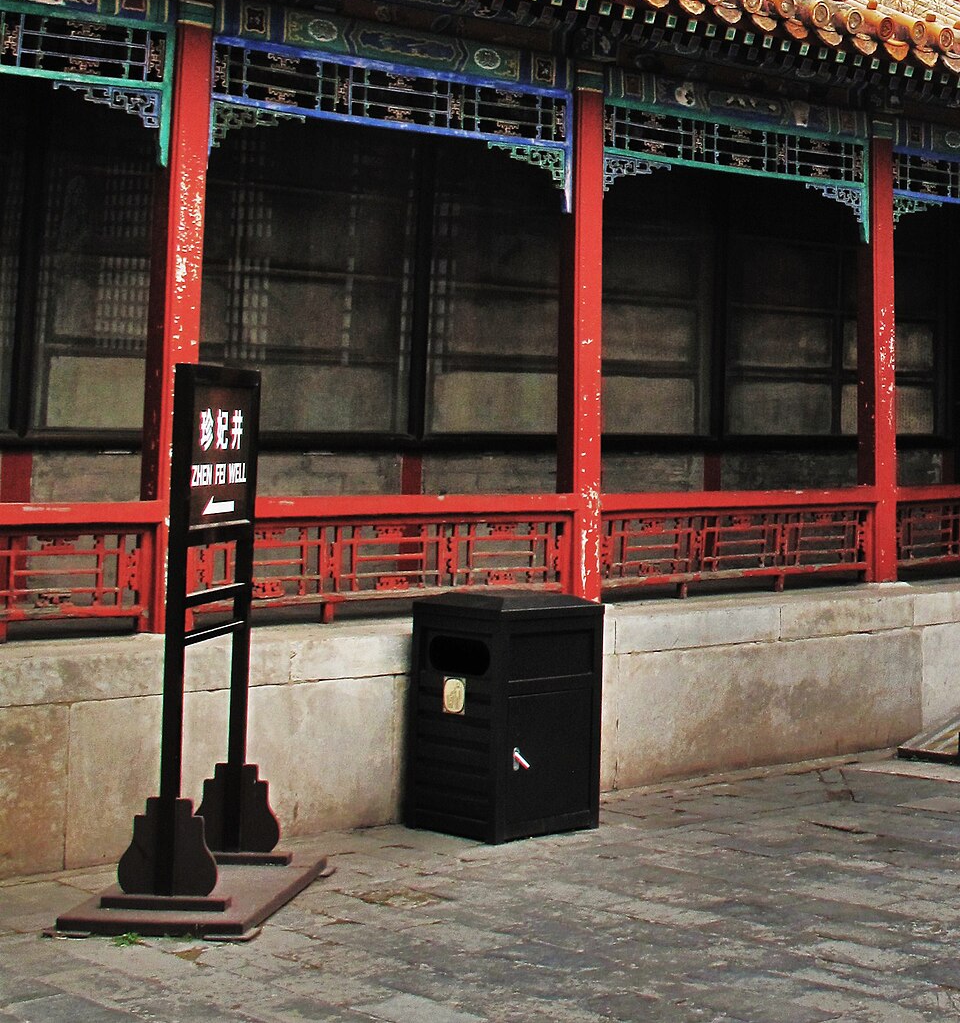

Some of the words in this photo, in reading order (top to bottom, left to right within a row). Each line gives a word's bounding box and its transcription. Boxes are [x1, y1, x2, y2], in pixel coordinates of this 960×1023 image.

[200, 408, 243, 451] 珍妃井
[191, 464, 212, 487] ZHEN
[214, 464, 226, 485] FEI
[228, 463, 247, 484] WELL
